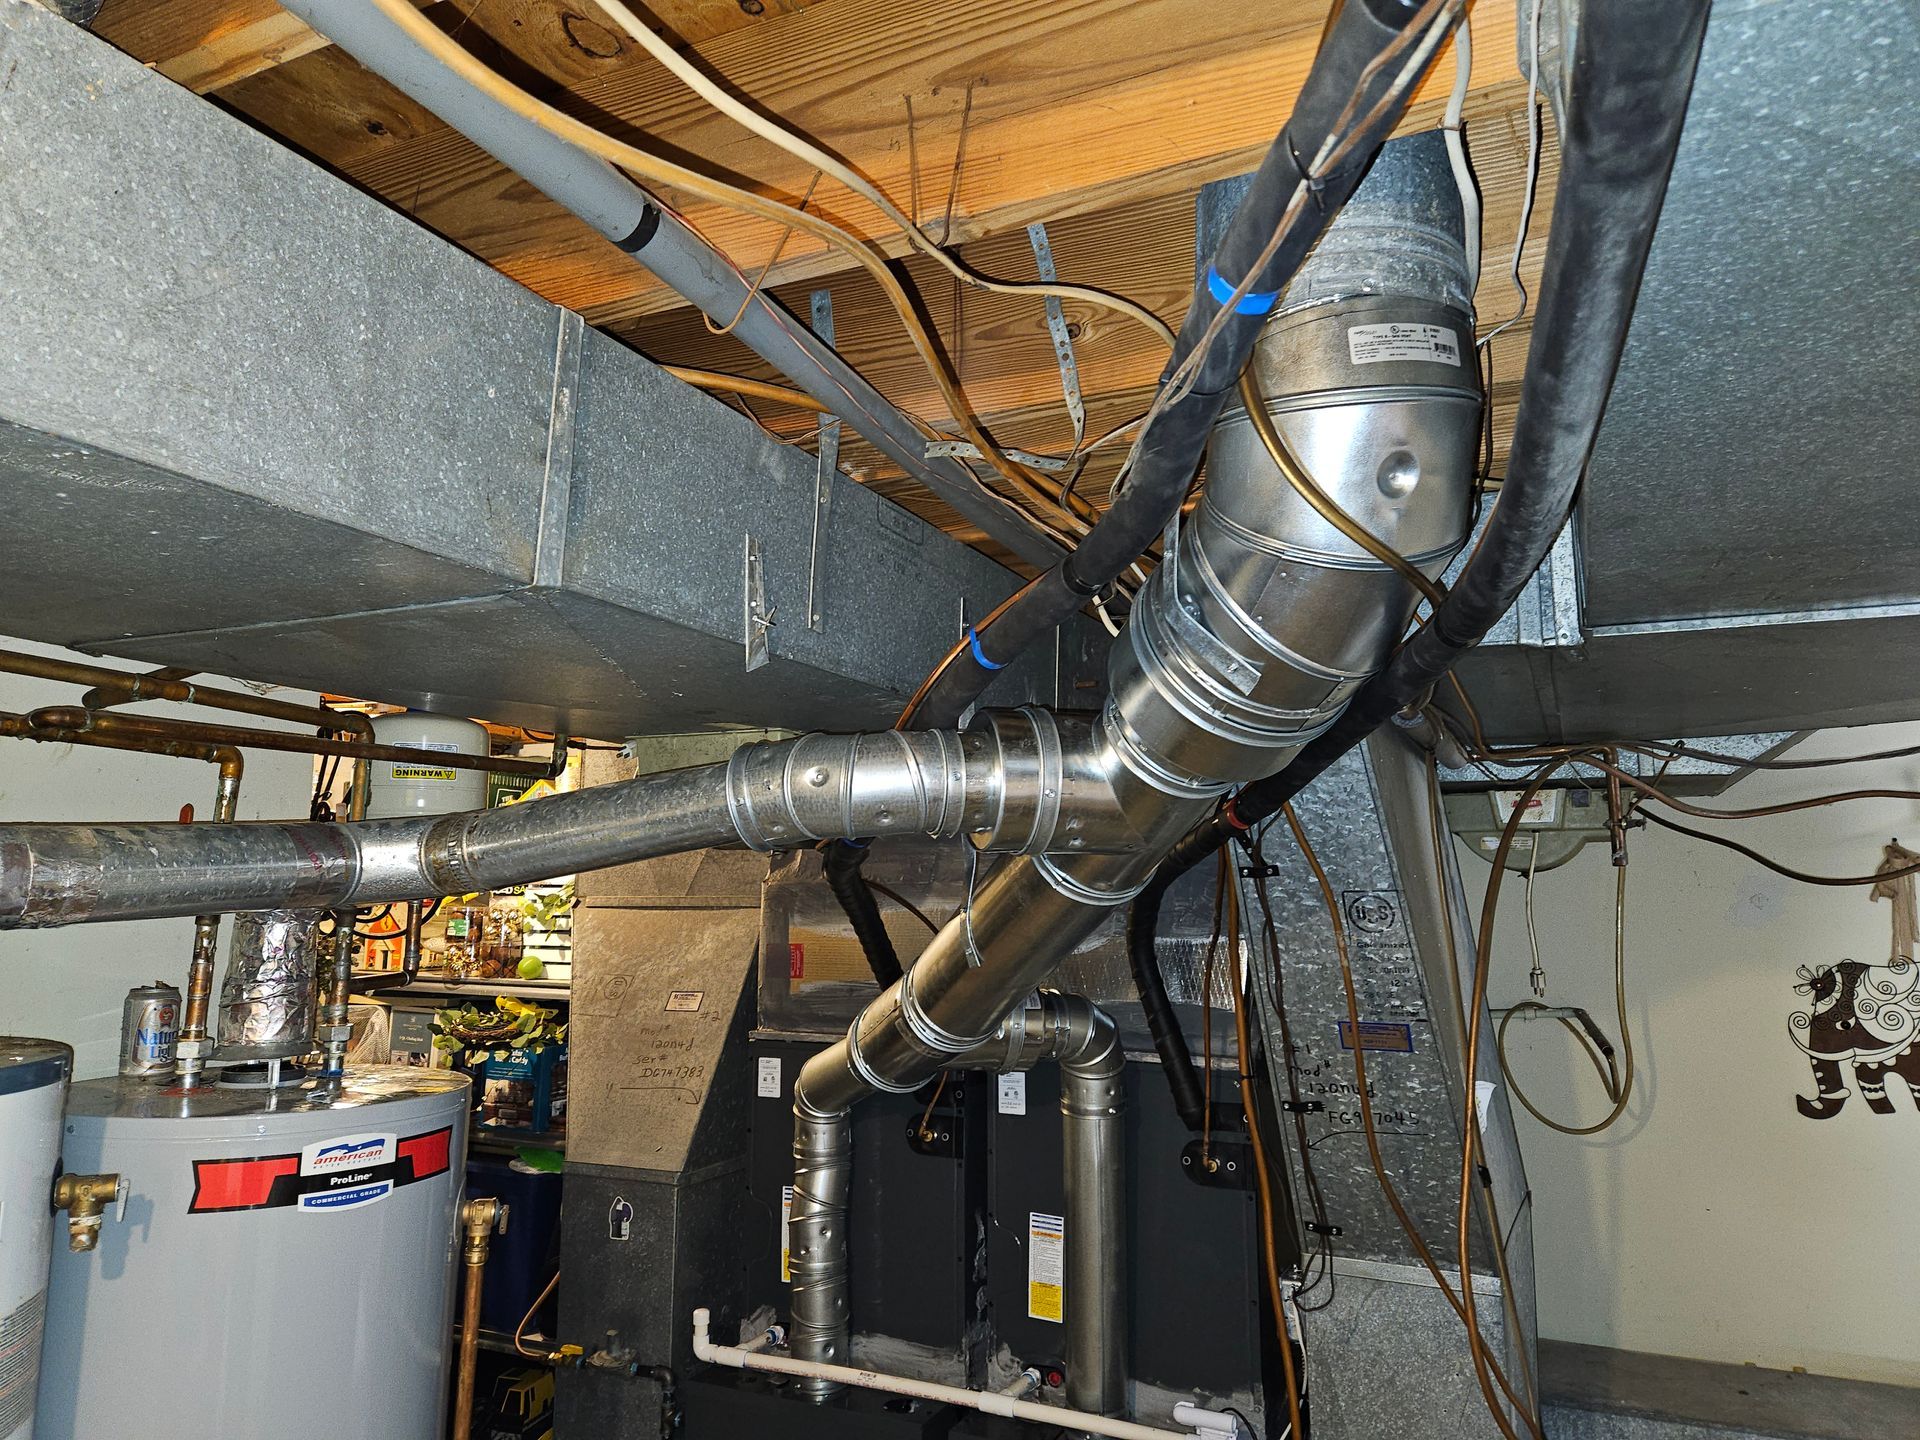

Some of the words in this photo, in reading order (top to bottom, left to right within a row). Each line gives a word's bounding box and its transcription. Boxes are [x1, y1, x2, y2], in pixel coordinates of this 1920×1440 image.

[395, 769, 443, 777] WARNING
[313, 1149, 383, 1165] american
[311, 1193, 358, 1205] COMMERCIAL
[359, 1188, 382, 1197] GRADE
